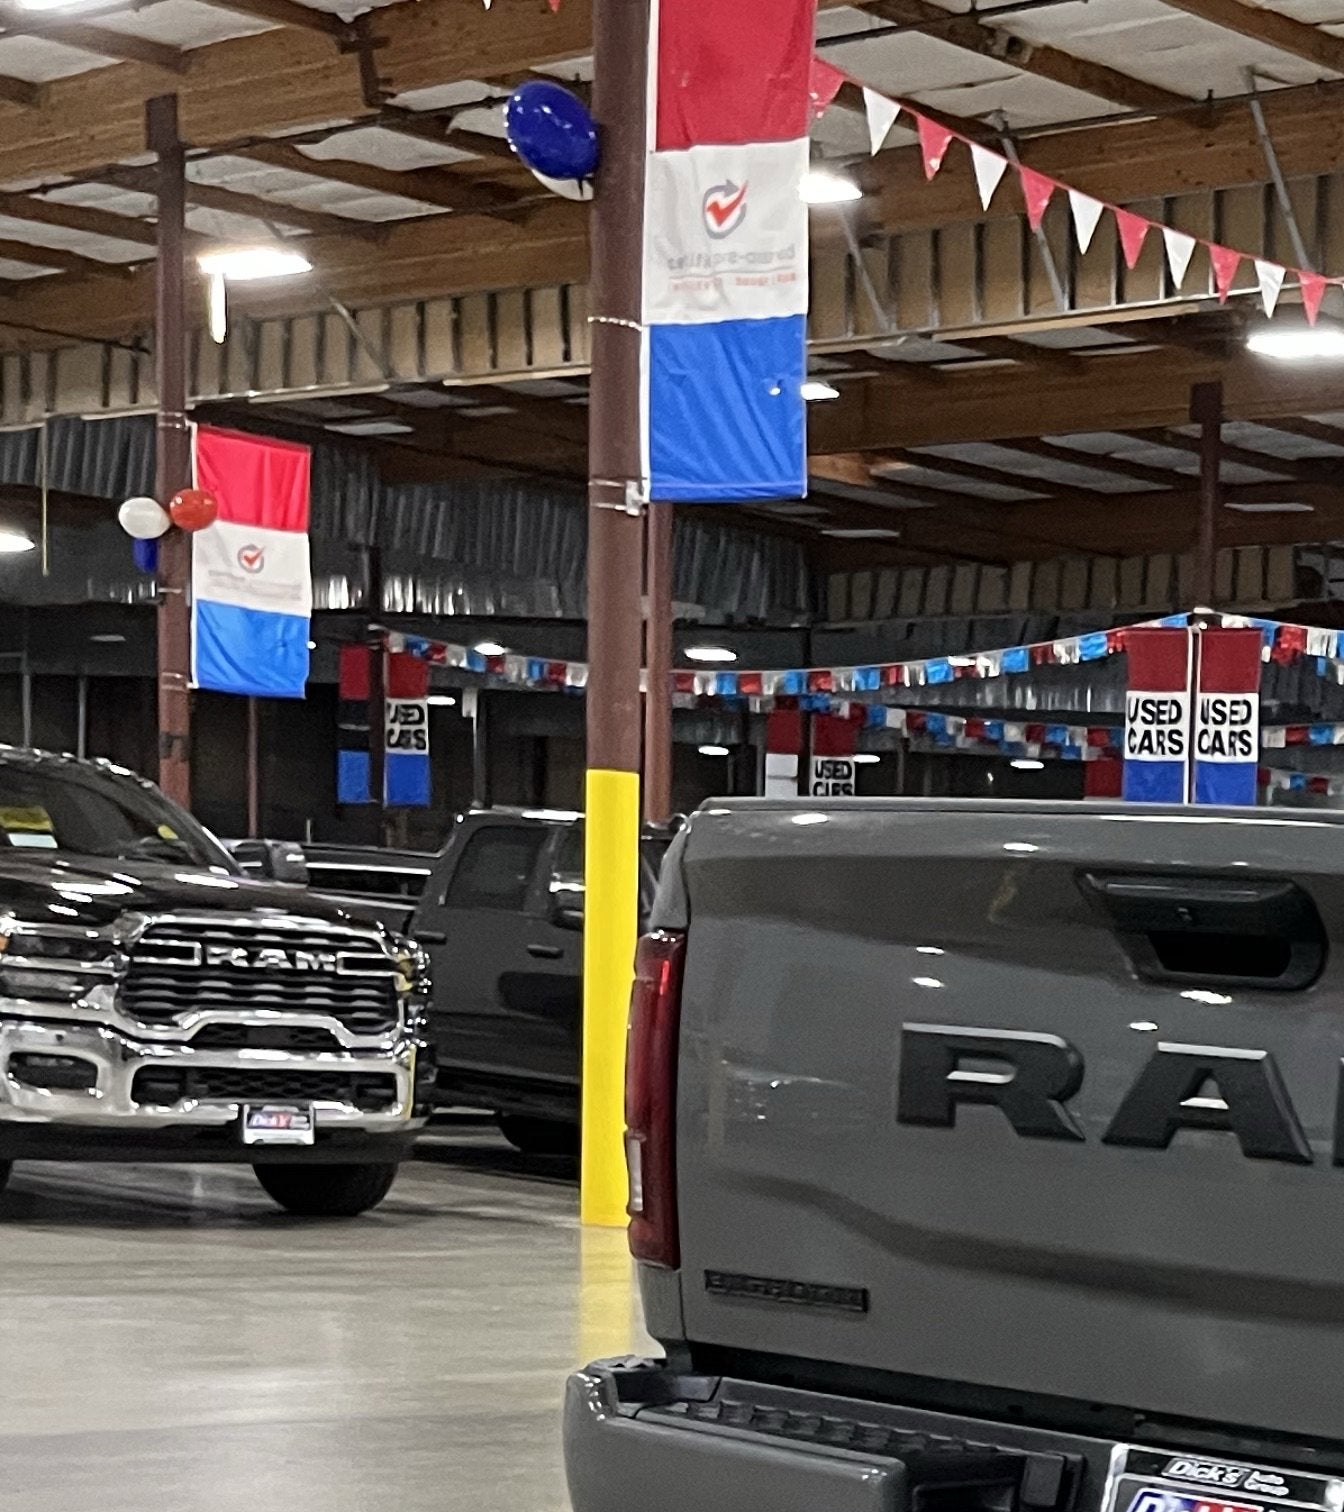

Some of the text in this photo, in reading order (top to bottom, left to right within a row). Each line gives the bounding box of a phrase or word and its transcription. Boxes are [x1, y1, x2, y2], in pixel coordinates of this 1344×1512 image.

[1127, 697, 1183, 725] USED
[1200, 698, 1253, 725] USED
[1127, 726, 1184, 756] CARS
[1197, 728, 1253, 757] CARS
[814, 760, 853, 781] USED
[206, 946, 336, 972] RAM
[1167, 1459, 1241, 1485] Dick's
